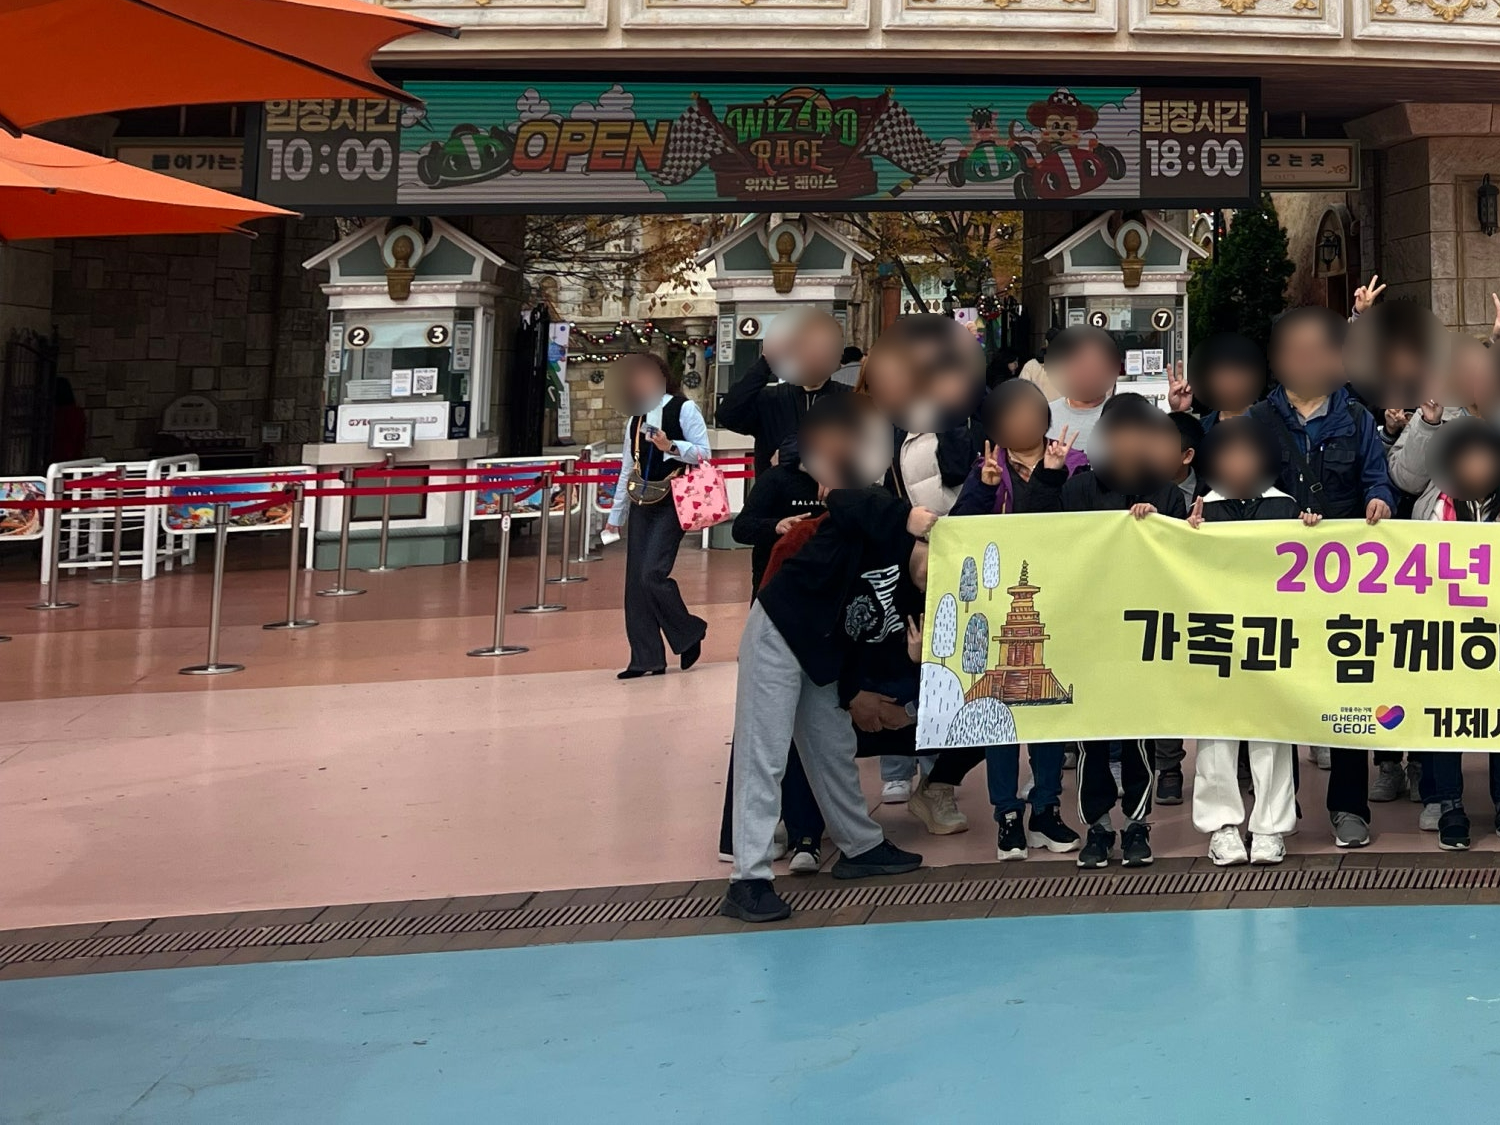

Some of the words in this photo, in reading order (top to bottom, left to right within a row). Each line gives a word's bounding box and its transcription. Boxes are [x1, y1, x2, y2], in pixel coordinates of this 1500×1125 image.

[265, 98, 400, 132] 입장시간
[1142, 100, 1248, 134] 퇴장시간
[512, 120, 673, 173] OPEN
[152, 154, 243, 170] 들어가는
[266, 138, 393, 181] 10:00
[750, 140, 834, 175] RACE
[1146, 139, 1244, 177] 18:00
[794, 176, 839, 190] 레이스
[742, 320, 755, 334] 4
[1092, 313, 1103, 327] 6
[1158, 313, 1168, 327] 7
[352, 329, 365, 345] 2
[432, 327, 444, 343] 3
[1276, 541, 1491, 607] 2024년
[1124, 610, 1298, 677] 가족과
[1321, 714, 1338, 722] BIG
[1340, 714, 1373, 722] HEART
[1333, 723, 1376, 734] GEOJE
